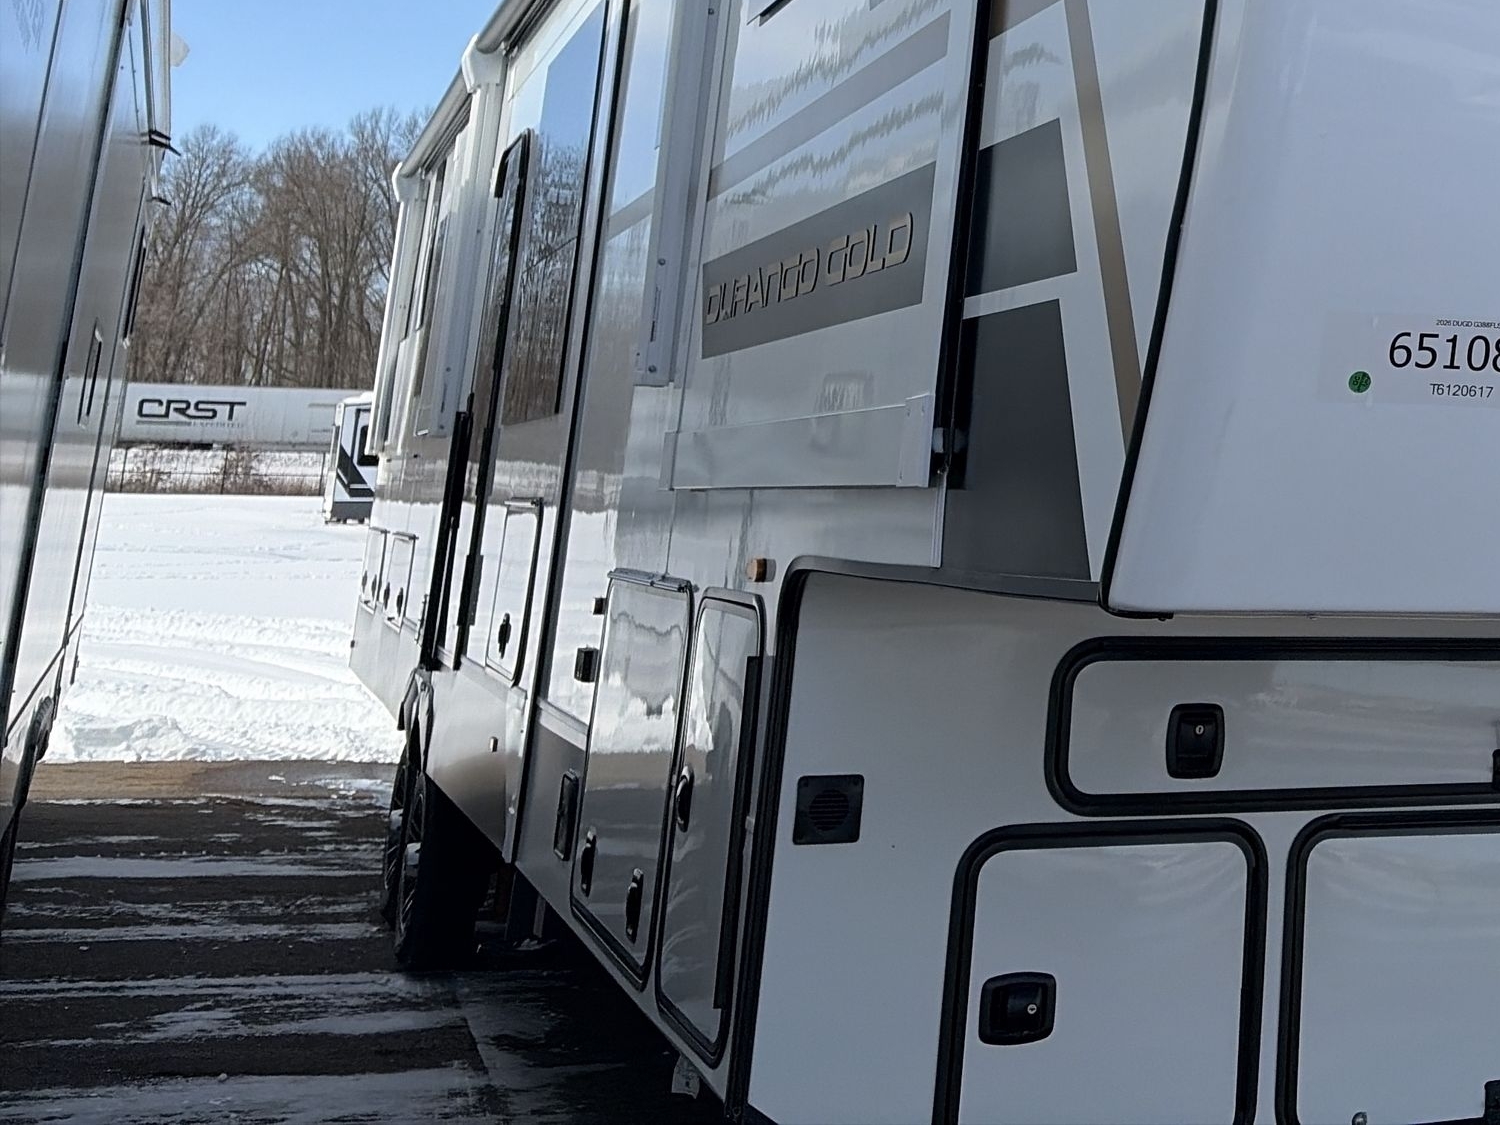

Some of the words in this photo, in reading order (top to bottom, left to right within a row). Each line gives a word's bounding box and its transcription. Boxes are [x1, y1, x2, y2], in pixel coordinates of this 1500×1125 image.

[704, 248, 820, 325] DURANGO
[826, 211, 914, 287] GOLD
[1429, 383, 1494, 399] T6120617
[137, 398, 247, 421] CRST
